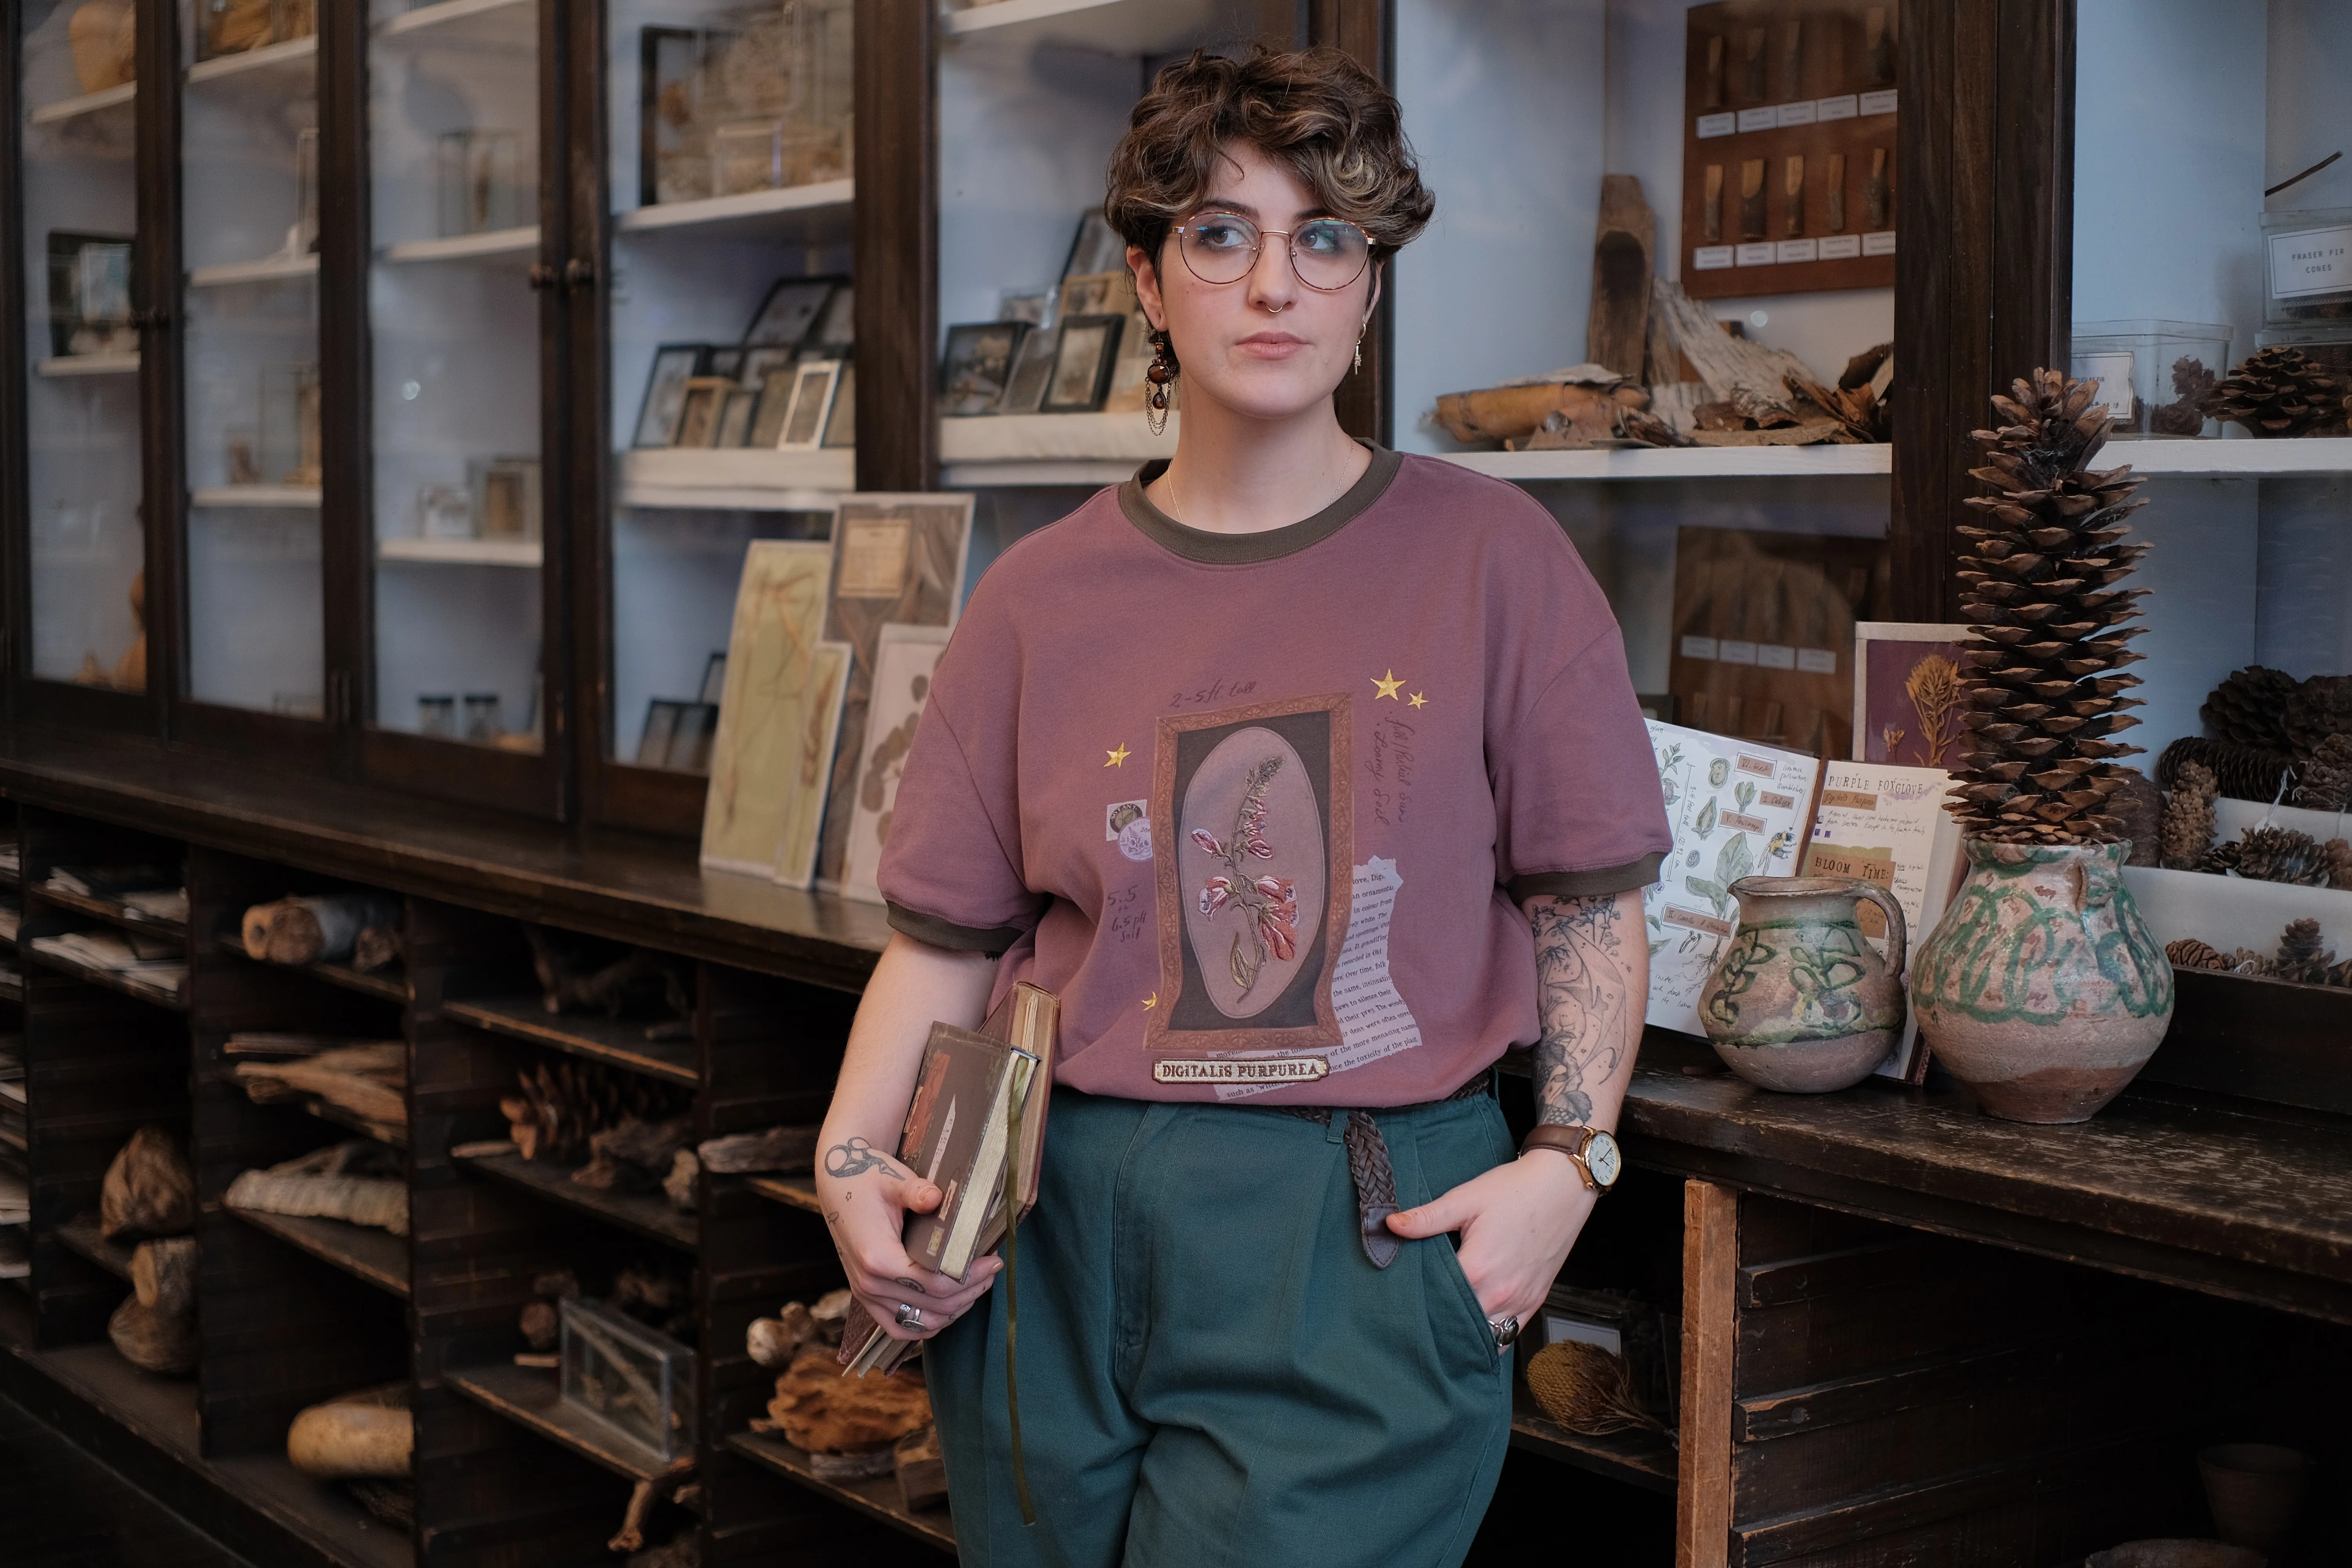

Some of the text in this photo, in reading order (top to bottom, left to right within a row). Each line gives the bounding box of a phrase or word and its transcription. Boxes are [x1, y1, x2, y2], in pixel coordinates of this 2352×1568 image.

[2292, 248, 2345, 261] FRASER FIR
[2306, 264, 2332, 273] CONES
[1230, 681, 1257, 697] tall
[1828, 775, 1923, 795] PURPLE FOXGLOVE
[1815, 856, 1889, 879] BLOOM TIME:
[1107, 884, 1138, 906] 5.5
[1362, 903, 1379, 911] colour
[1112, 910, 1147, 932] 6.5 pH
[1342, 954, 1364, 967] recorded
[1375, 961, 1387, 969] folk
[1344, 985, 1361, 994] name,
[1334, 1003, 1349, 1012] paws
[1358, 993, 1378, 1004] silence
[1378, 989, 1392, 997] their
[1345, 1013, 1359, 1022] their
[1361, 1007, 1376, 1018] prey.
[1388, 999, 1405, 1007] woody
[1350, 1026, 1365, 1034] dens
[1365, 1020, 1381, 1029] were
[1340, 1045, 1352, 1053] the
[1353, 1039, 1370, 1049] more
[1372, 1027, 1401, 1042] menacing
[1356, 1049, 1381, 1063] toxicity
[1404, 1036, 1418, 1047] plant
[1238, 1062, 1319, 1078] PURPUREA
[1227, 1089, 1243, 1098] such
